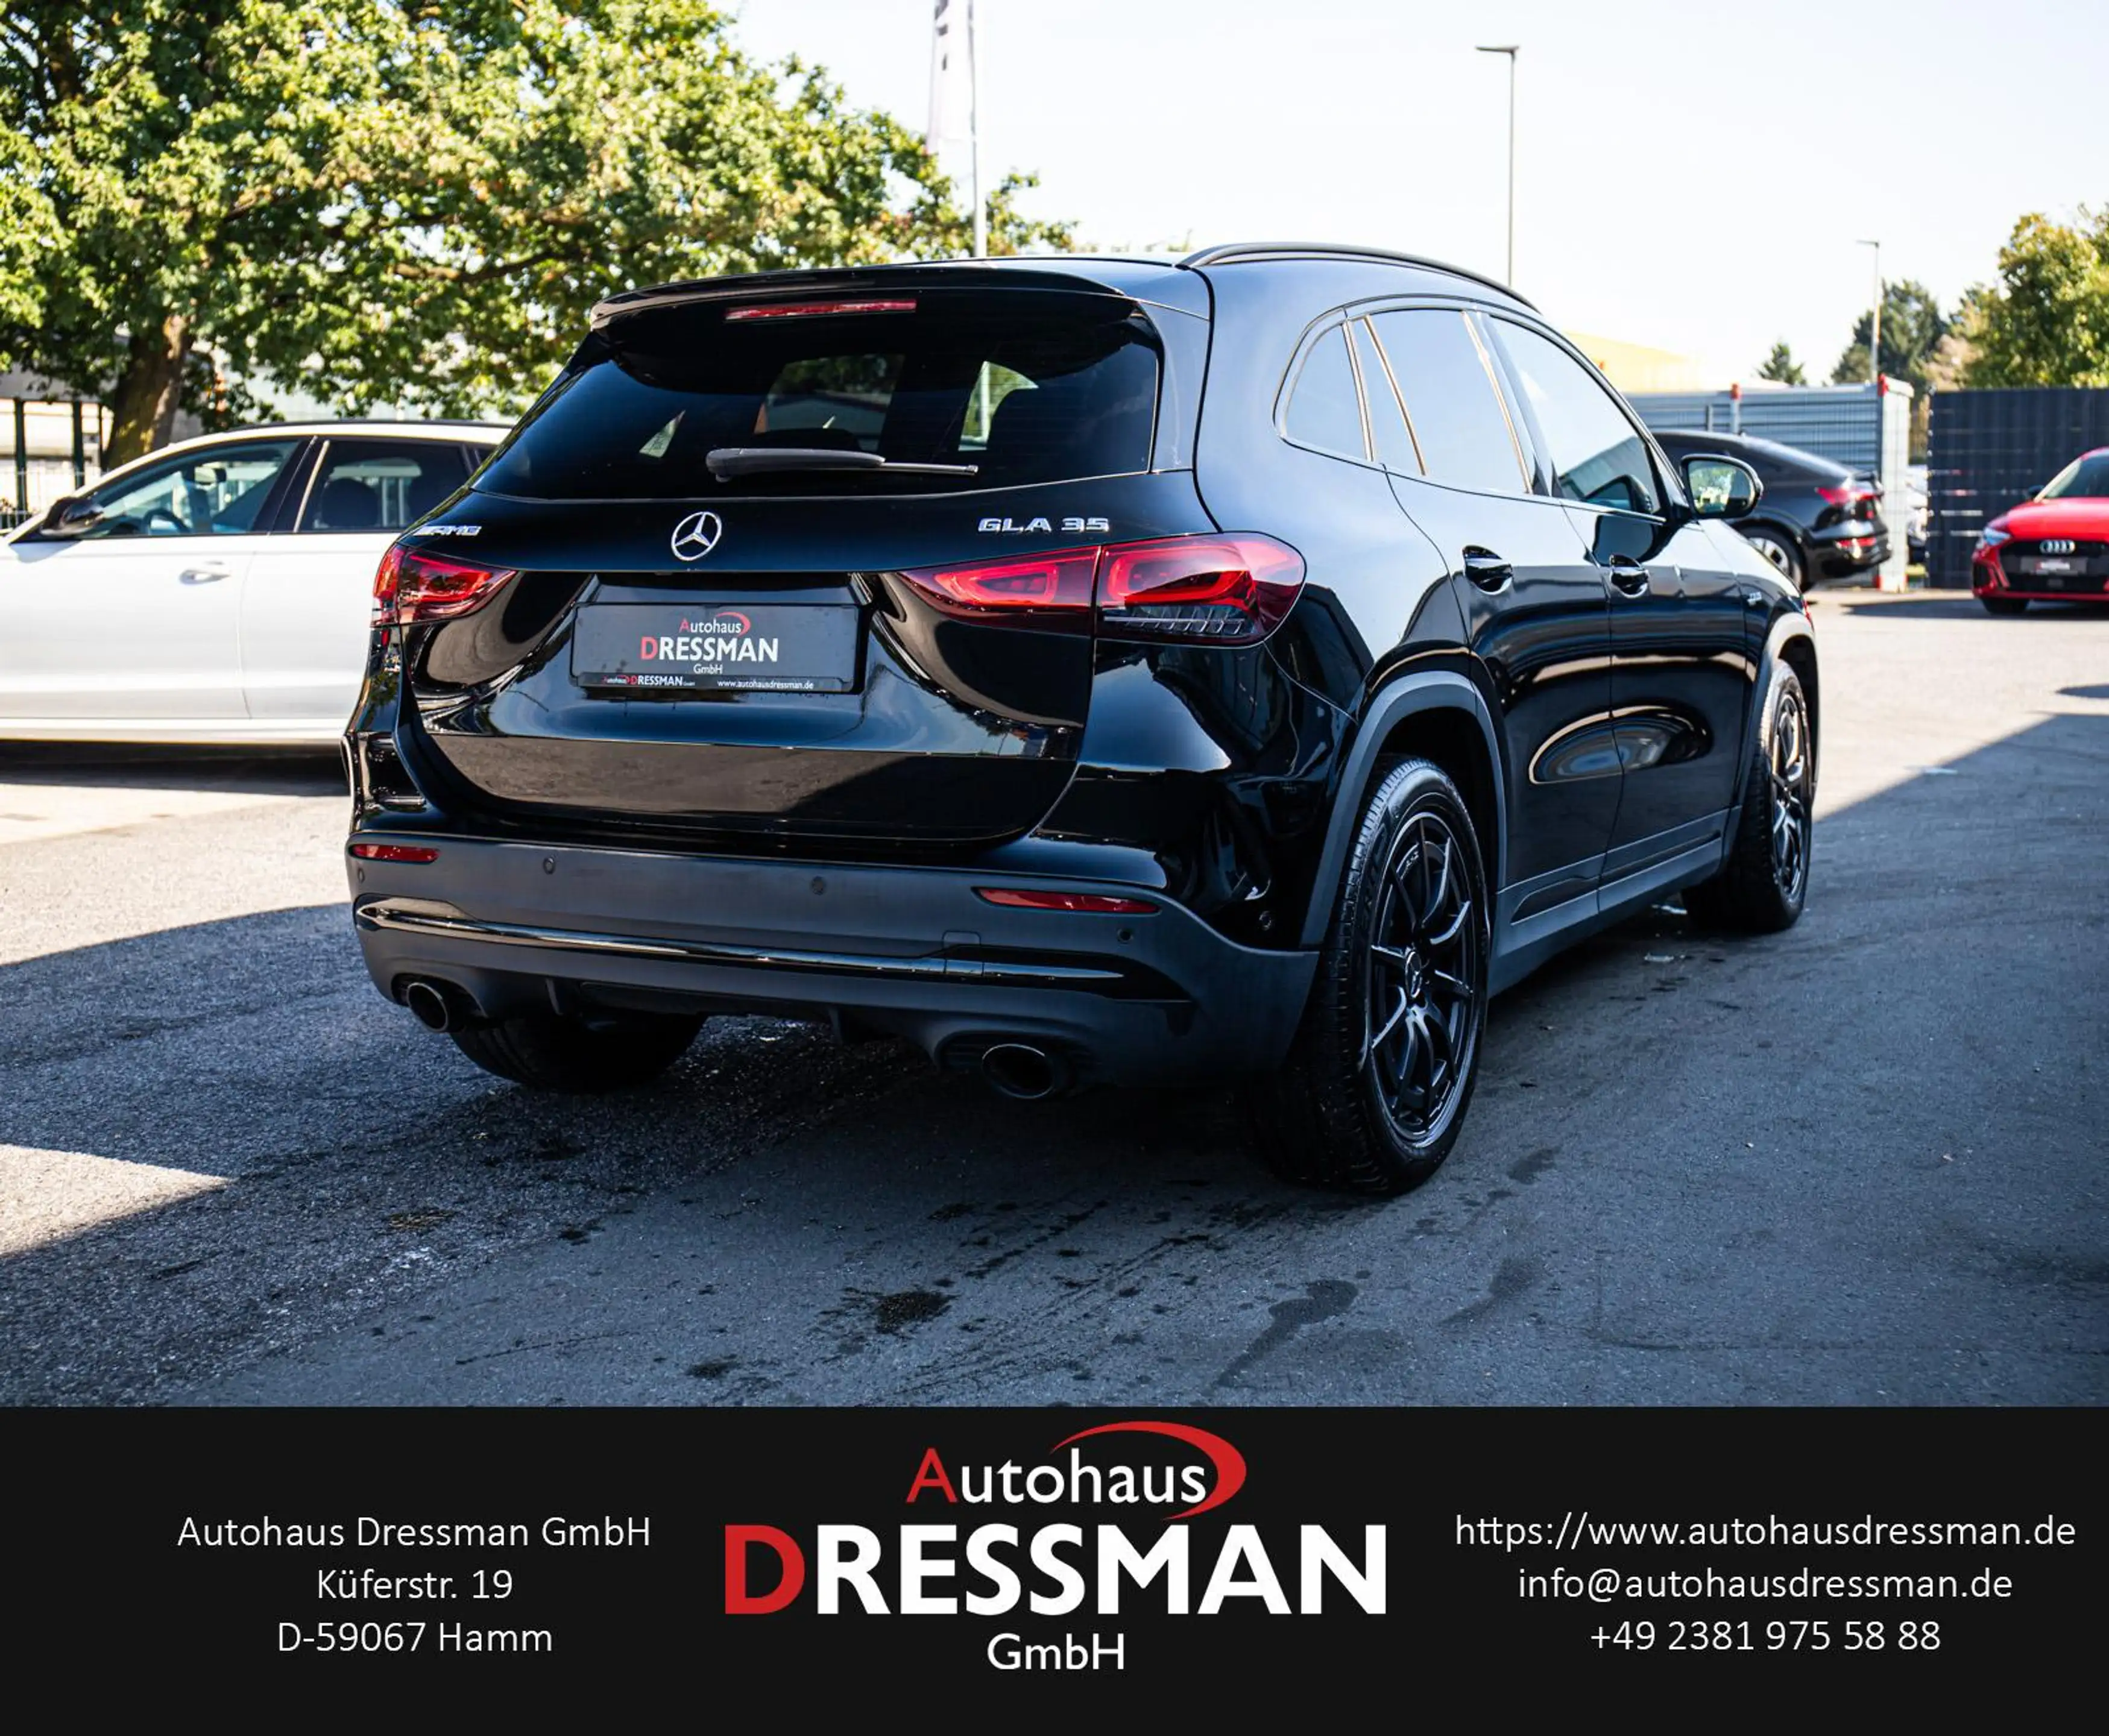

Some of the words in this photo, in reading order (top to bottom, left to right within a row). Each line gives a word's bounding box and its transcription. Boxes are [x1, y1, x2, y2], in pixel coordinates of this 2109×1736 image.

[977, 517, 1051, 533] GLA
[1061, 517, 1110, 533] 35
[679, 617, 742, 634] Autohaus
[640, 636, 779, 662] DRESSMAN
[693, 664, 723, 675] GmbH
[630, 675, 683, 686] DRESSMAN
[717, 679, 814, 690] www.autohausdressman.de
